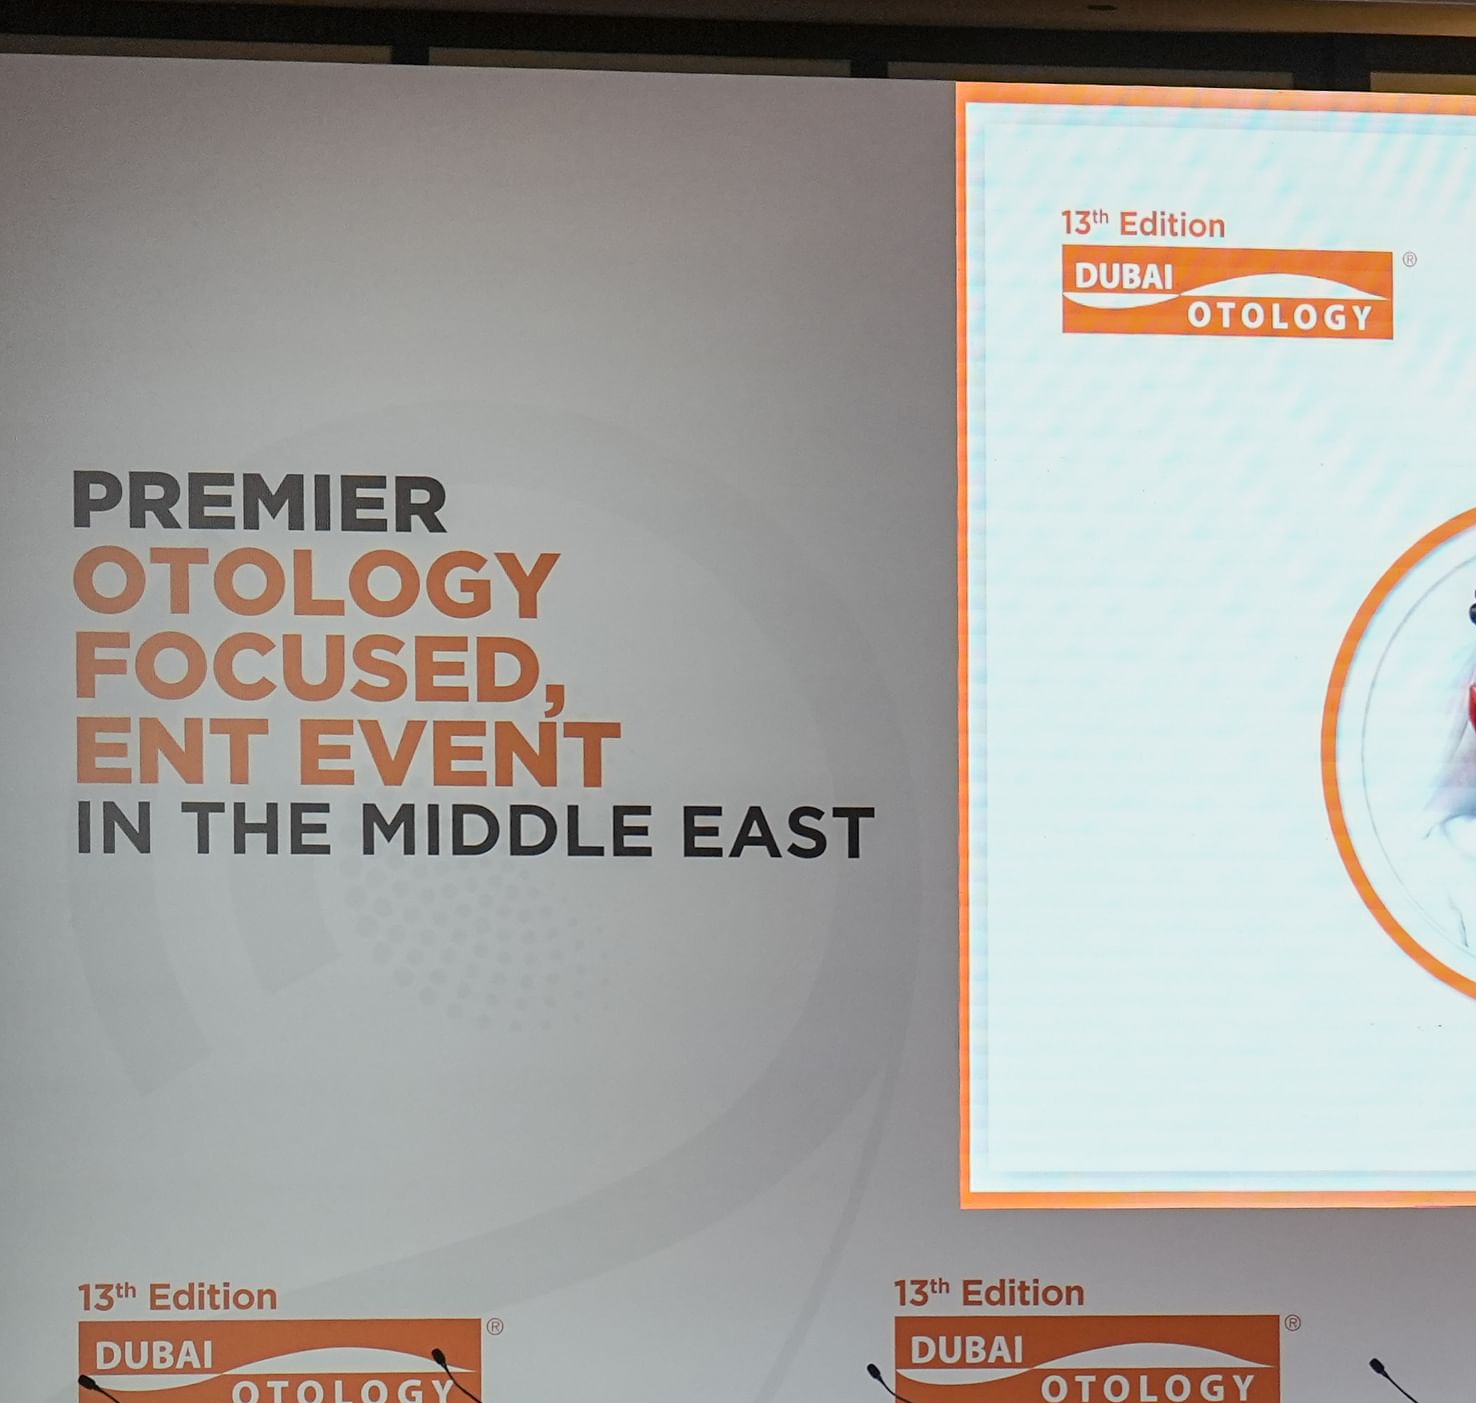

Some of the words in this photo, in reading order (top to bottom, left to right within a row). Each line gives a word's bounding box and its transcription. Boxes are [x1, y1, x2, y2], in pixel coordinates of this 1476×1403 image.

[1062, 210, 1109, 234] 13th
[1120, 212, 1225, 237] Edition
[1075, 262, 1172, 289] DUBAI
[1188, 301, 1371, 331] OTOLOGY
[73, 471, 447, 534] PREMIER
[73, 546, 561, 619] OTOLOGY
[75, 631, 564, 715] FOCUSED,
[76, 717, 269, 784] ENT
[300, 718, 621, 788] EVENT
[78, 801, 152, 855] IN
[182, 801, 331, 855] THE
[363, 803, 653, 857] MIDDLE
[683, 806, 875, 859] EAST
[79, 1282, 136, 1312] 13th
[150, 1282, 277, 1311] Edition
[894, 1278, 949, 1306] 13th
[963, 1278, 1085, 1306] Edition
[96, 1341, 212, 1369] DUBAI
[911, 1335, 1022, 1364] DUBAI
[1041, 1374, 1255, 1403] OTOLOGY
